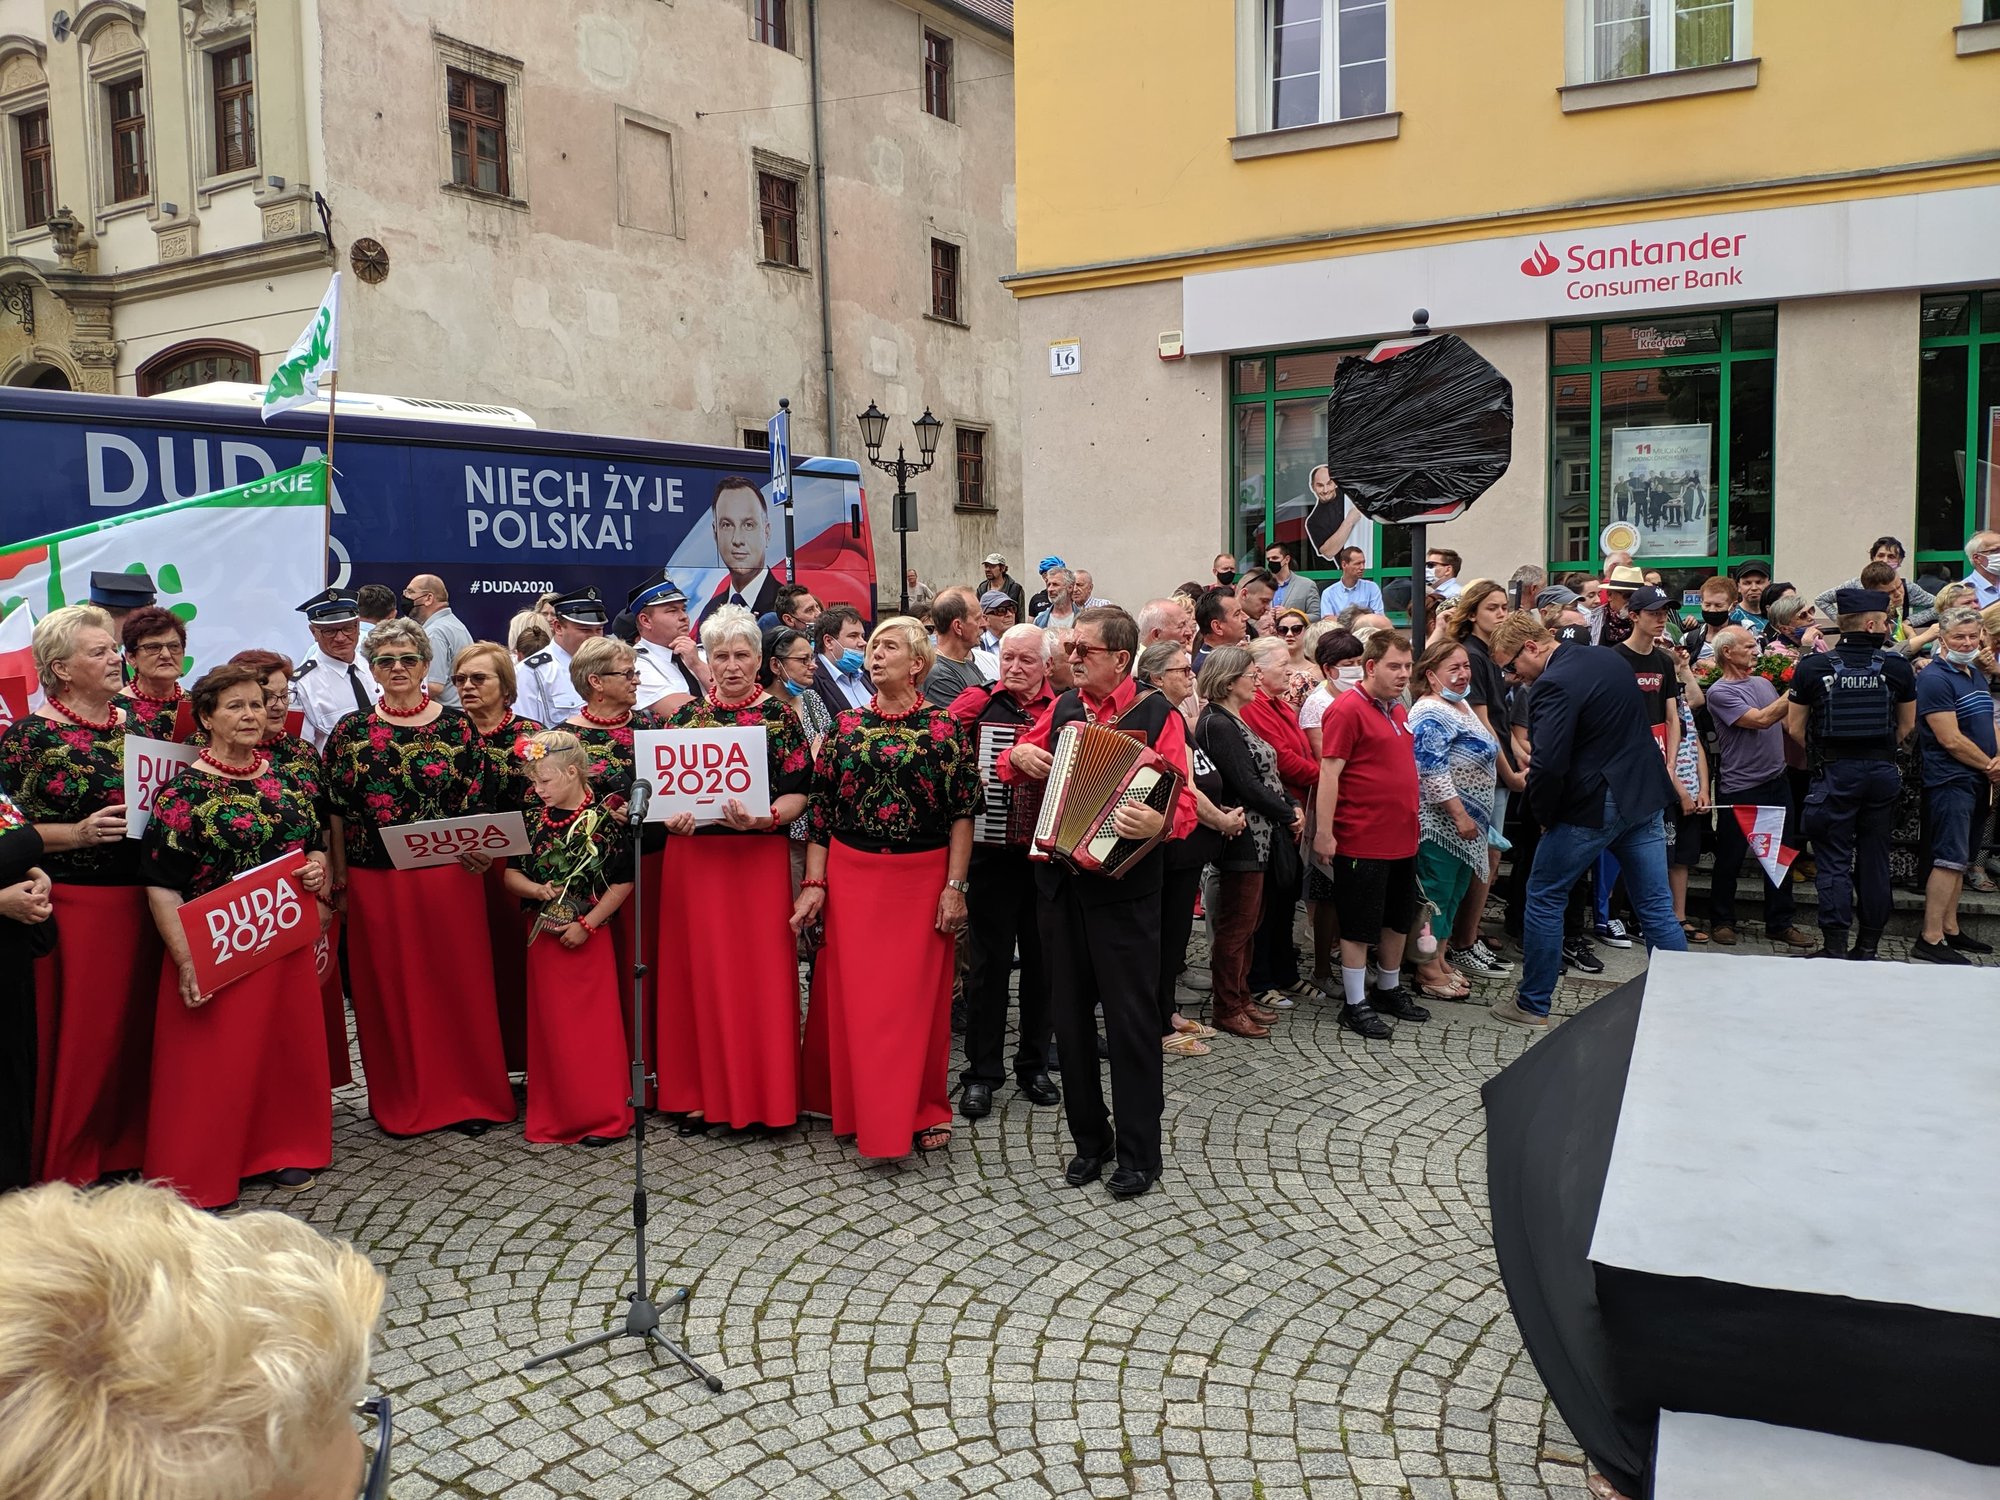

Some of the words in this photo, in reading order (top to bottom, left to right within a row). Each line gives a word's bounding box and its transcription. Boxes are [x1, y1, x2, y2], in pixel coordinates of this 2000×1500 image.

[1567, 232, 1746, 273] Santander
[1567, 275, 1679, 300] Consumer
[1684, 266, 1743, 289] Bank
[1633, 328, 1657, 339] Bank
[1055, 352, 1075, 367] 16
[1635, 444, 1651, 454] 11
[465, 465, 590, 508] NIECH
[603, 465, 684, 512] ŻYJE
[467, 510, 633, 550] POLSKA!
[470, 581, 554, 593] #DUDA2020
[1841, 676, 1878, 688] POLICJA
[138, 754, 189, 786] DUD
[654, 742, 749, 771] DUDA
[656, 768, 751, 796] 2020
[404, 824, 506, 848] DUDA
[411, 837, 511, 858] 2020
[205, 877, 298, 939] DUDA
[212, 901, 302, 965] 2020
